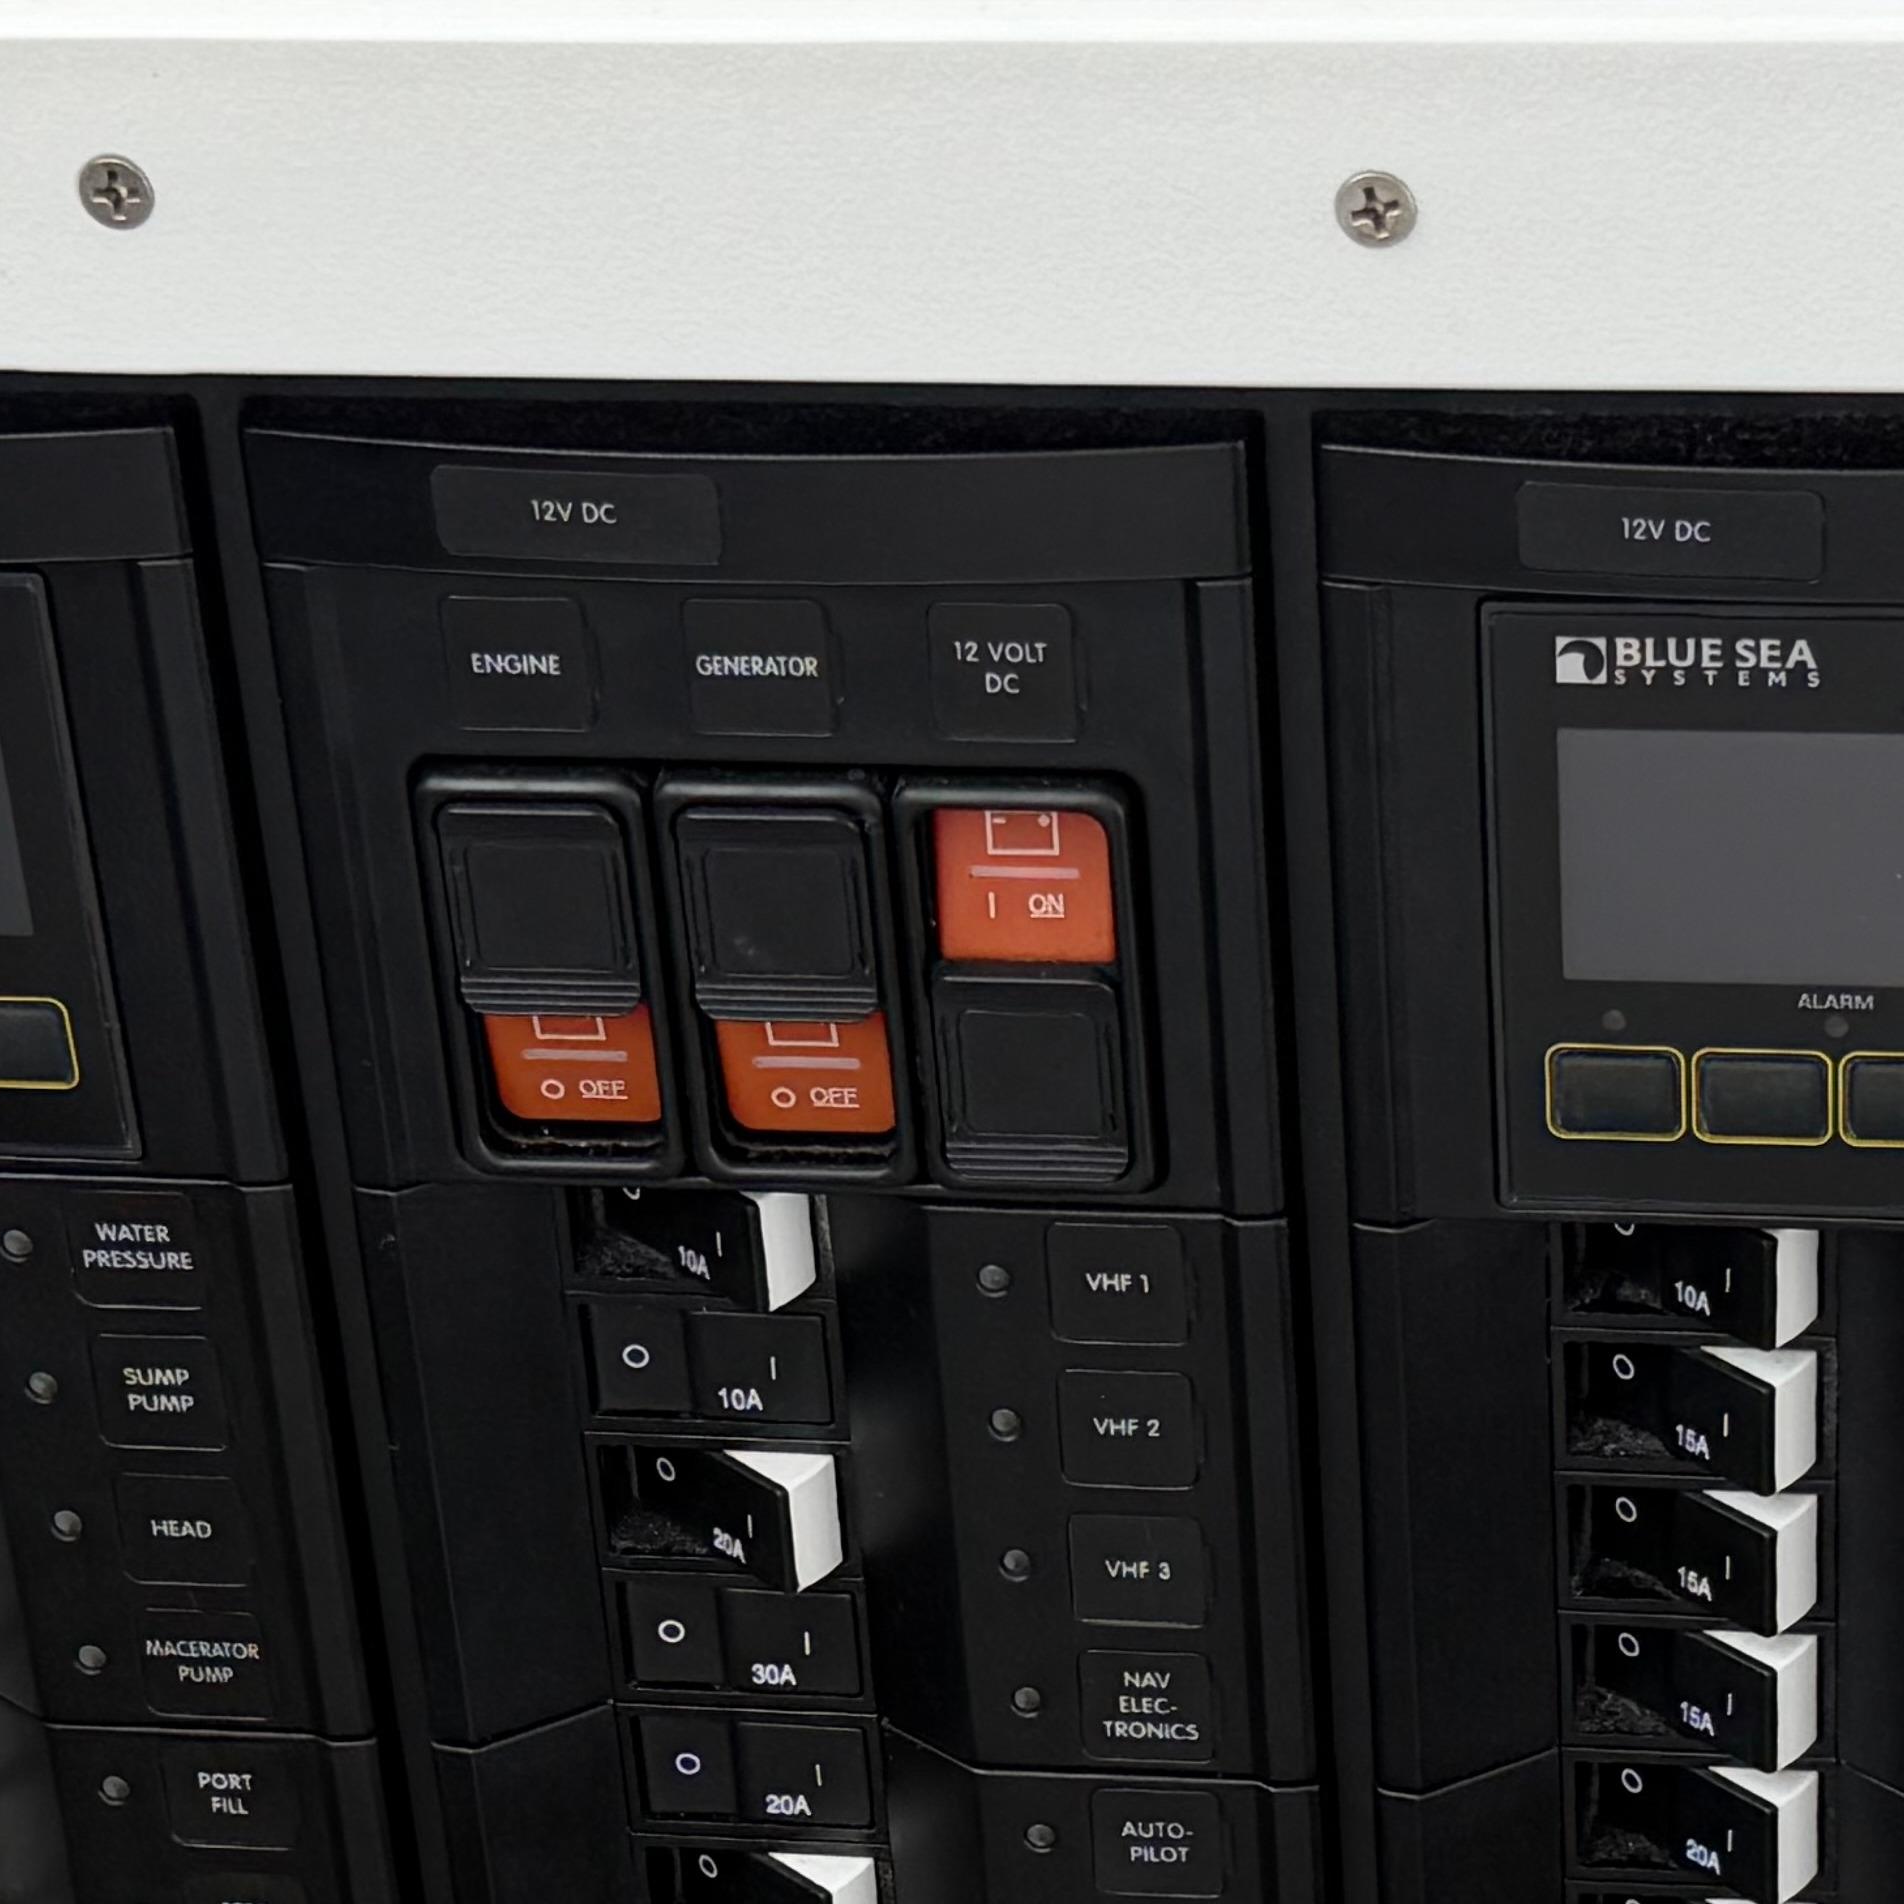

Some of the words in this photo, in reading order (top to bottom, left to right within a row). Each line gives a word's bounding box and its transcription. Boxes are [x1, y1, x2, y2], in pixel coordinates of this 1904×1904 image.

[532, 500, 572, 521] 12V
[582, 502, 616, 523] DC
[1622, 518, 1665, 540] 12V
[1675, 520, 1710, 542] DC
[954, 641, 979, 662] 12
[988, 642, 1046, 663] VOLT
[1615, 637, 1723, 667] BLUE
[1735, 639, 1817, 669] SEA
[472, 653, 560, 675] ENGINE
[696, 655, 817, 676] GENERATOR
[985, 672, 1019, 693] DC
[1615, 669, 1820, 687] SYSTEMS
[1029, 894, 1064, 918] ON
[1798, 993, 1873, 1009] ALARM
[579, 1080, 628, 1099] OFF
[810, 1087, 860, 1108] OFF
[95, 1223, 170, 1242] WATER
[83, 1250, 193, 1270] PRESSURE
[1086, 1273, 1131, 1292] VHF
[1140, 1274, 1149, 1293] 1
[123, 1368, 189, 1385] SUMP
[128, 1394, 194, 1412] PUMP
[718, 1388, 763, 1411] 10A
[1093, 1418, 1138, 1436] VHF
[1147, 1419, 1160, 1436] 2
[151, 1520, 211, 1538] HEAD
[1105, 1560, 1149, 1578] VHF
[1159, 1562, 1170, 1580] 3
[146, 1640, 259, 1659] MACERATOR
[179, 1665, 233, 1682] PUMP
[752, 1664, 796, 1685] 30A
[1124, 1672, 1170, 1688] NAV
[1119, 1696, 1177, 1714] ELEC-
[1103, 1721, 1199, 1740] TRONICS
[198, 1772, 251, 1790] PORT
[211, 1797, 248, 1814] FILL
[766, 1794, 811, 1815] 20A
[1122, 1821, 1193, 1839] AUTO-
[1131, 1846, 1188, 1862] PILOT
